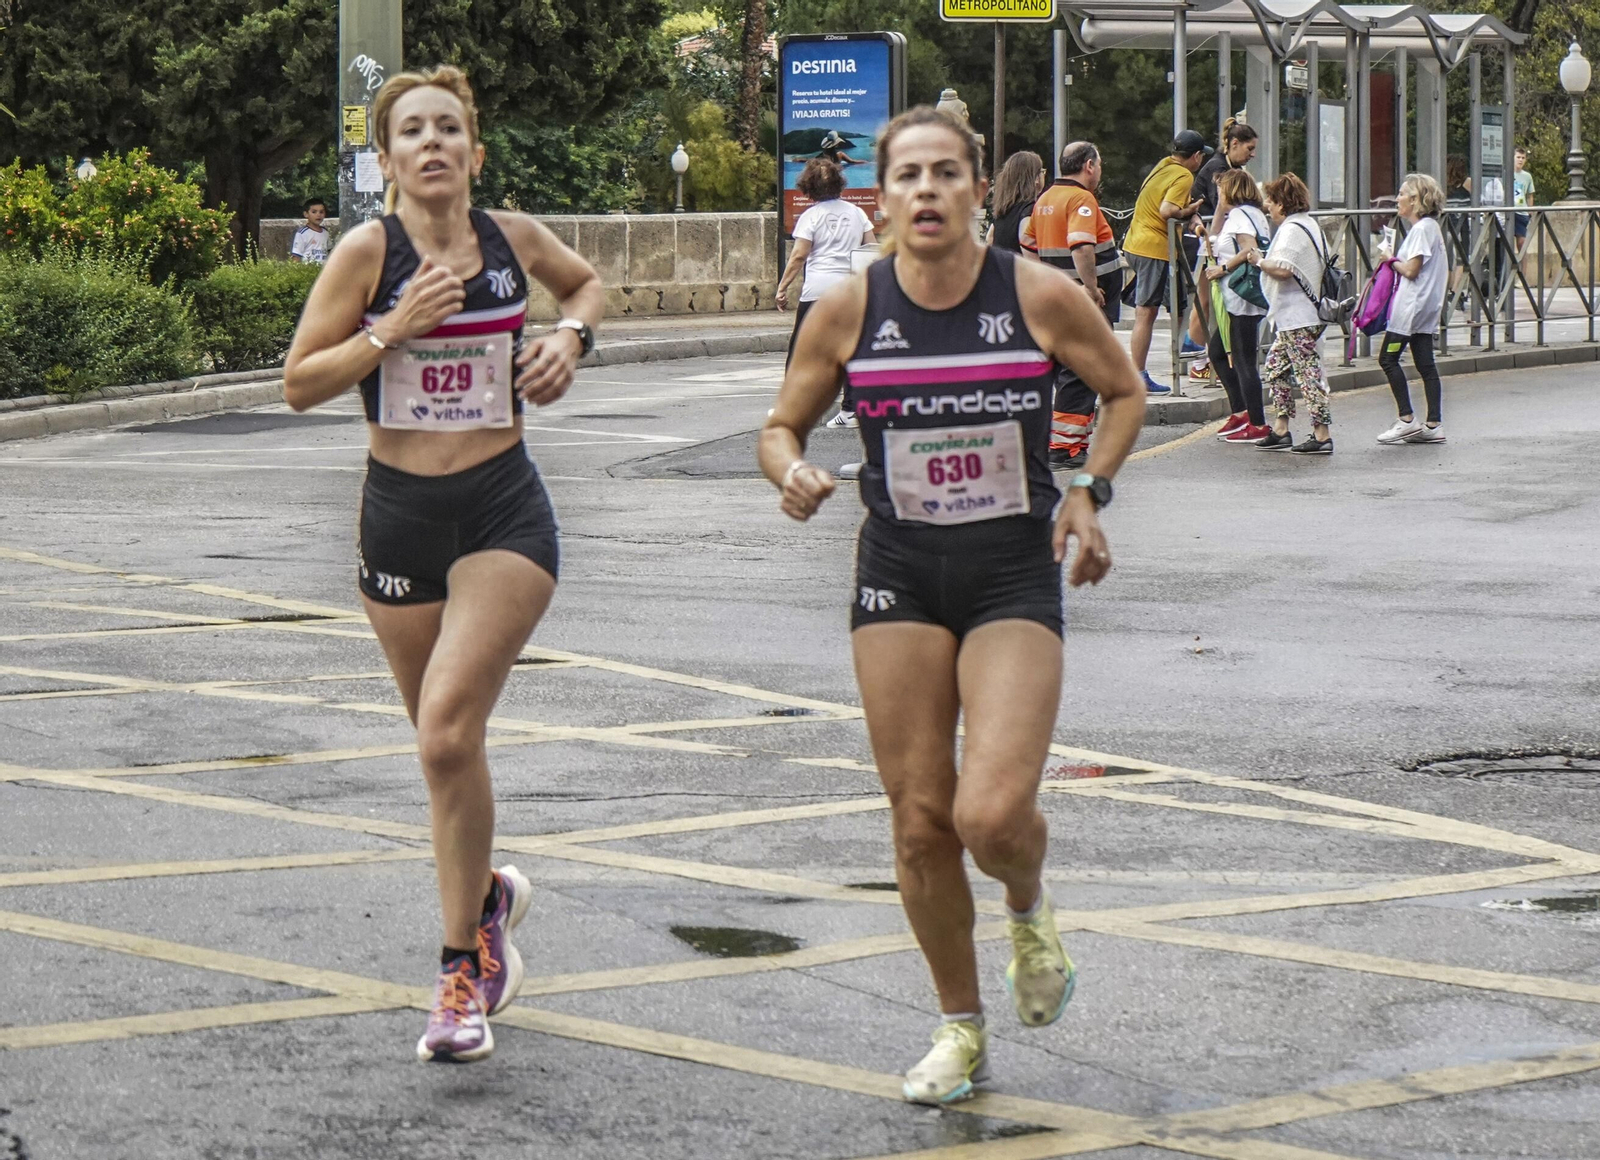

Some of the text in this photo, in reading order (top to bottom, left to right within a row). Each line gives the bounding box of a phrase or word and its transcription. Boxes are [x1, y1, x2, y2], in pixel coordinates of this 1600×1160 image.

[949, 0, 1047, 11] METROPOLITANO
[792, 109, 850, 119] ¡VIAJA GRATIS!
[421, 363, 473, 394] 629
[434, 407, 483, 420] vithas
[927, 453, 983, 486] 630
[944, 495, 996, 513] vithas
